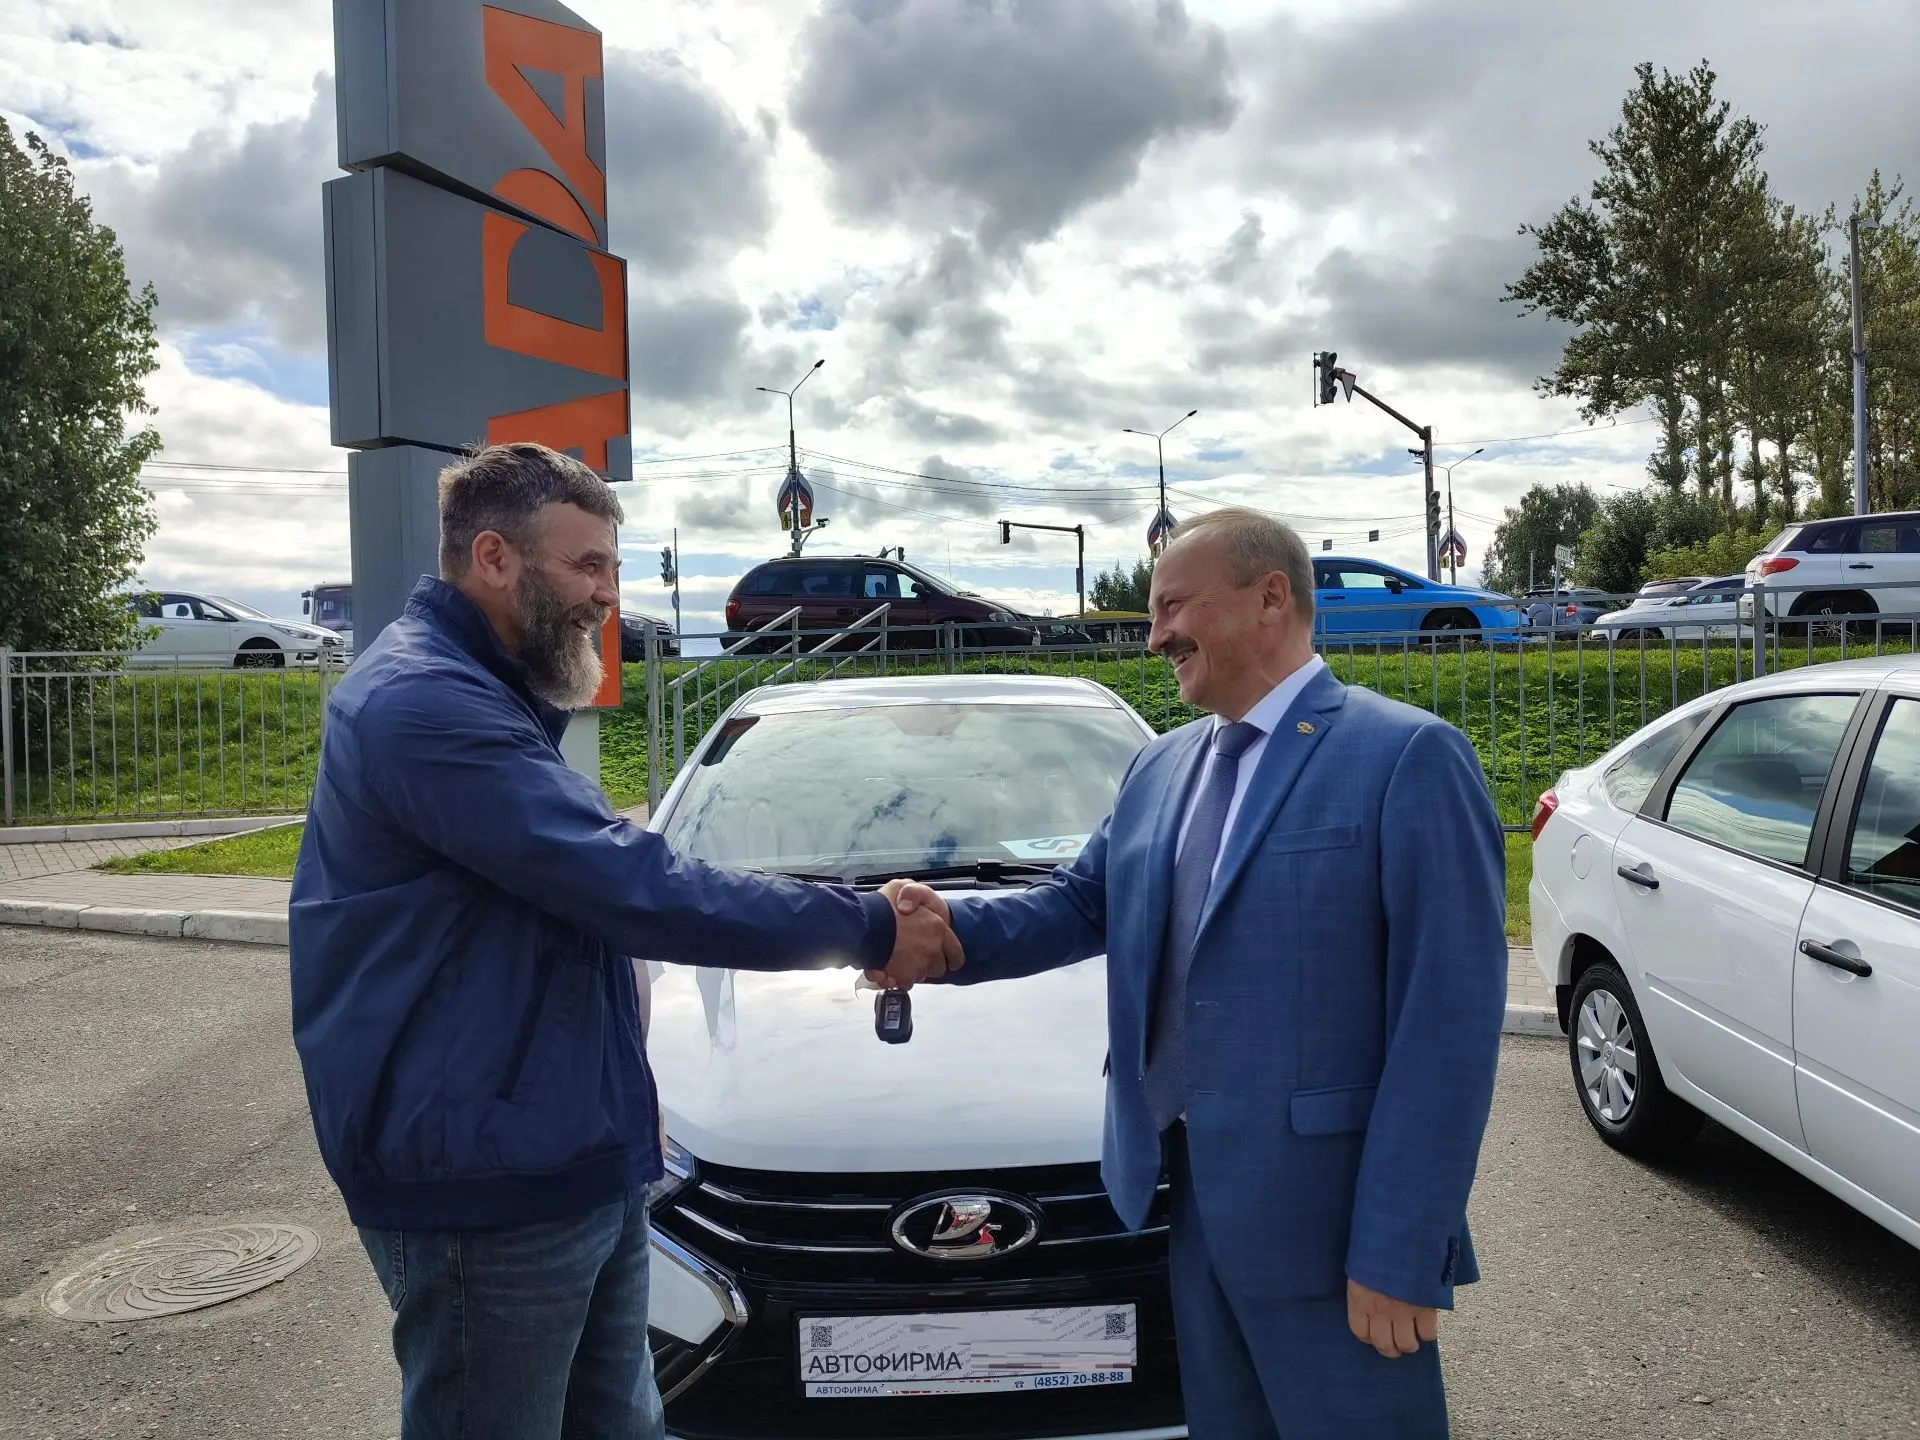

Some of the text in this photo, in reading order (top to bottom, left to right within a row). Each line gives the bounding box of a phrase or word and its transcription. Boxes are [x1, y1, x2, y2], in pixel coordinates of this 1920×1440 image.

[808, 1351, 962, 1374] АВТОФИРМА
[1034, 1371, 1124, 1388] (4852) 20-88-88
[816, 1386, 879, 1395] АВТОФИРМА
